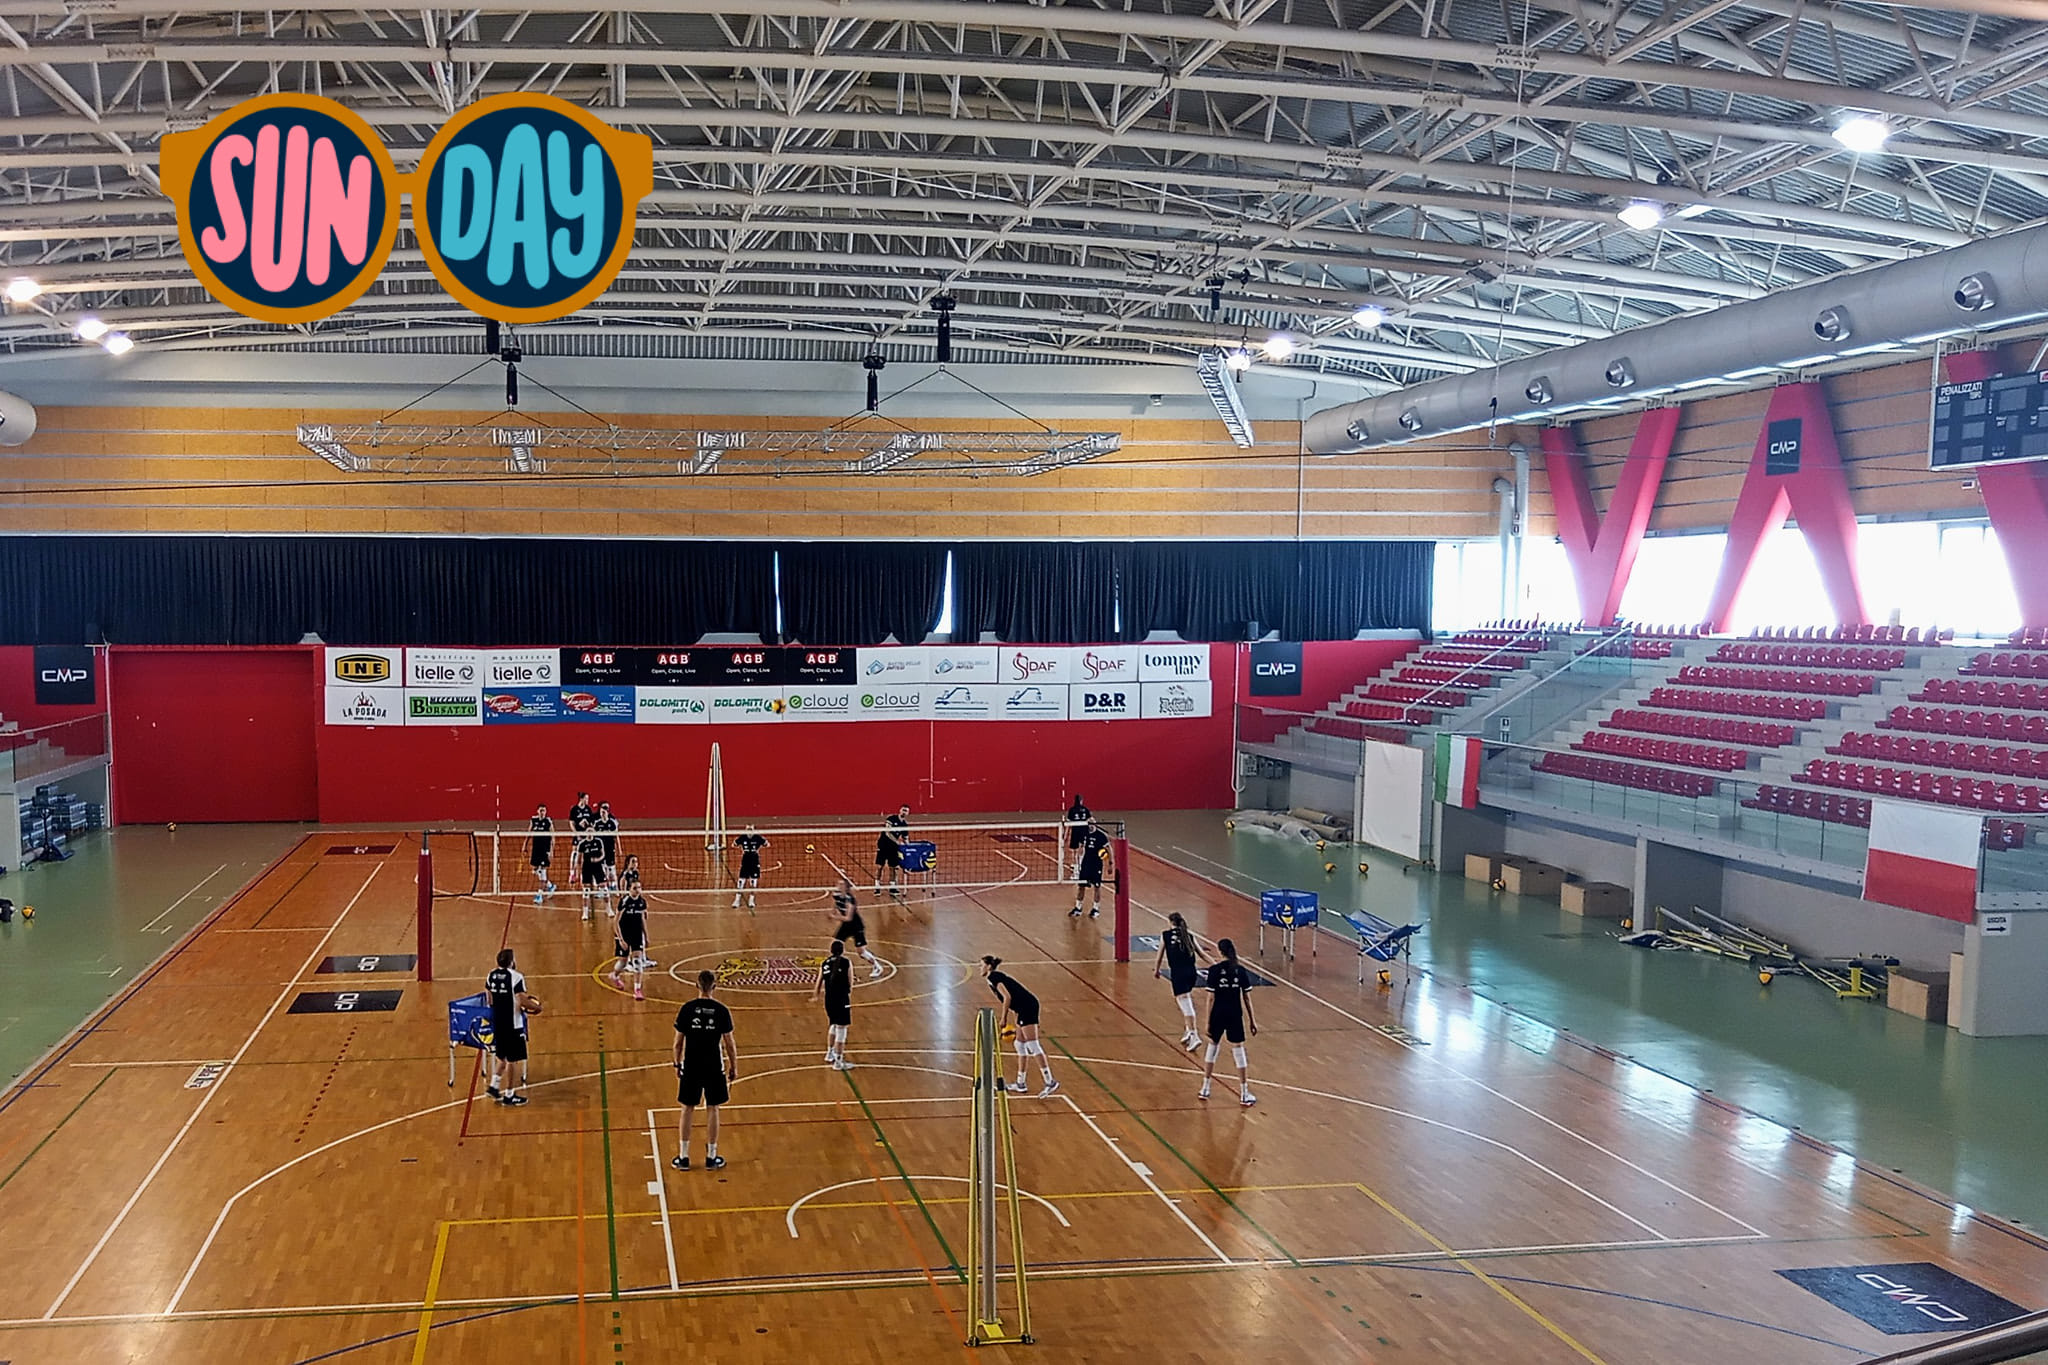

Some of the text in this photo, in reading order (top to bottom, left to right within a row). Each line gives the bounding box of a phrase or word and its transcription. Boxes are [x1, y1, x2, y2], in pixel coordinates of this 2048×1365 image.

[1940, 381, 1983, 396] PENALIZZATI
[1770, 440, 1797, 455] CMP
[582, 653, 613, 664] AGB
[658, 654, 689, 664] AGB
[733, 653, 763, 664] AGB
[807, 653, 837, 664] AGB
[1145, 654, 1201, 669] tommy
[343, 662, 382, 674] INE
[415, 665, 455, 680] tielle
[493, 666, 533, 681] tielle
[1256, 662, 1296, 677] CMP
[42, 668, 87, 683] CMP
[412, 699, 475, 714] BORSATTO
[639, 698, 689, 708] DOLOMITI
[714, 698, 763, 708] DOLOMITI
[1084, 693, 1126, 707] D&R
[342, 707, 387, 718] LA POSADA
[1855, 1272, 1969, 1323] CMP
